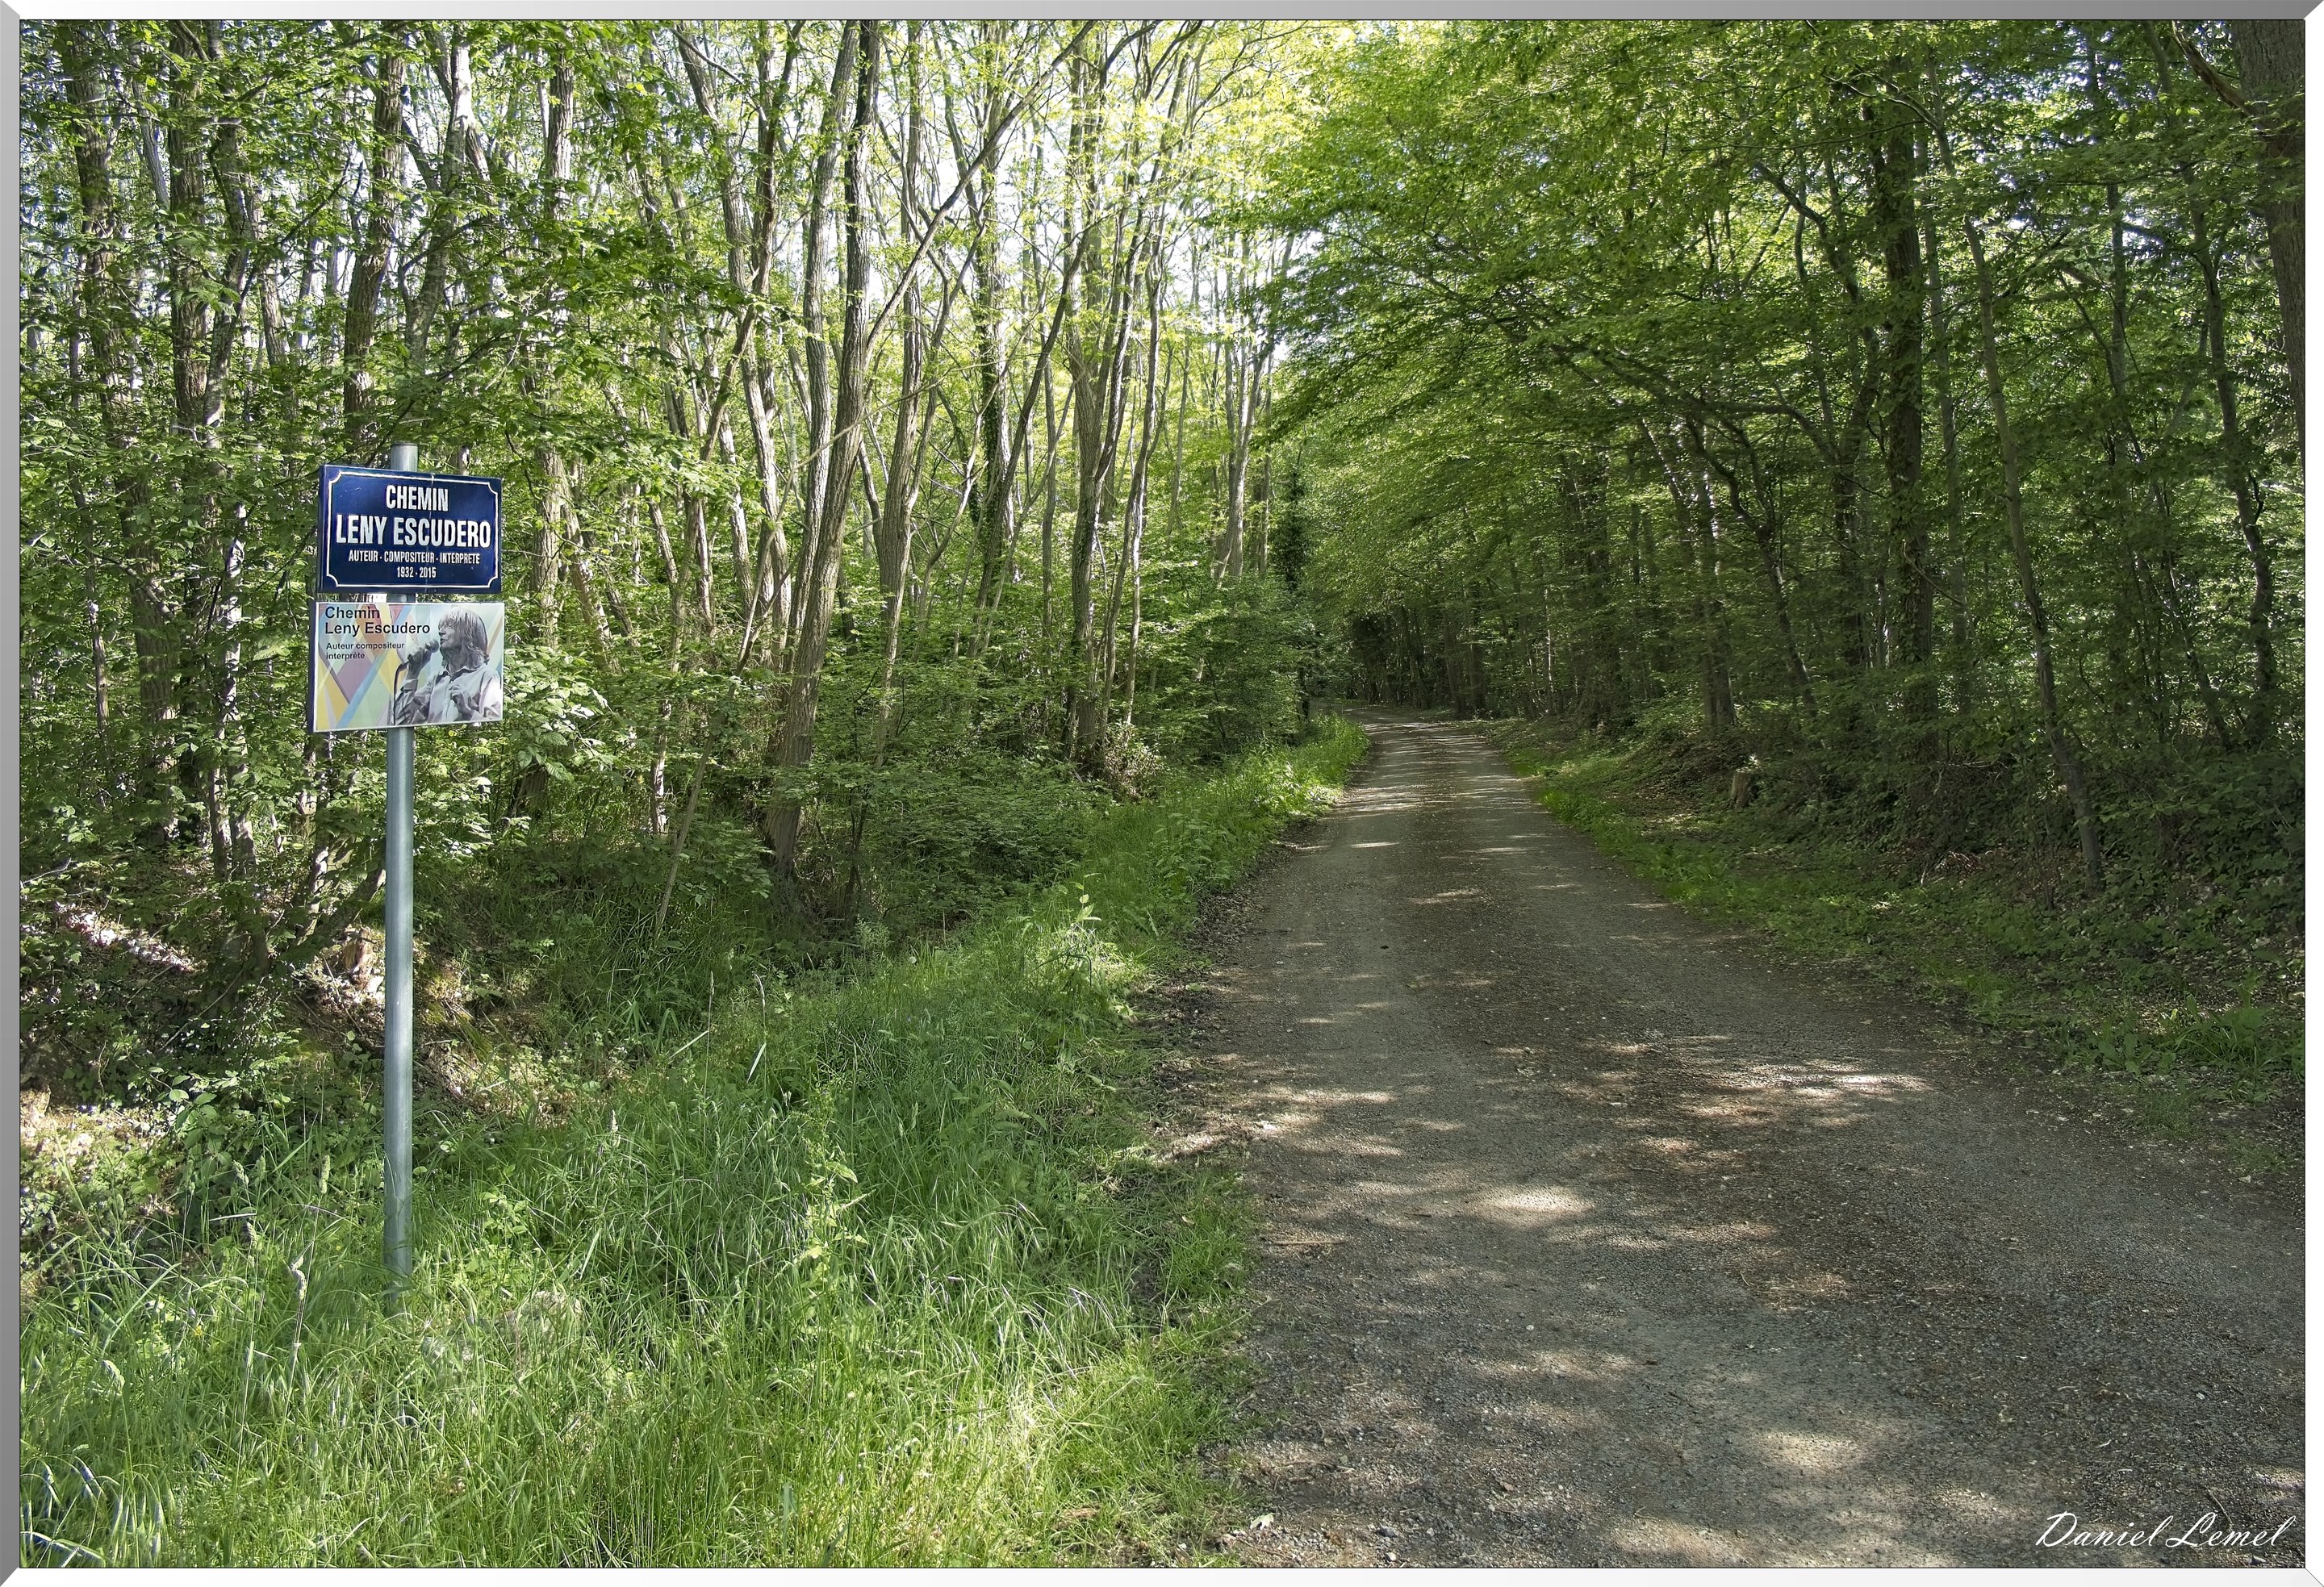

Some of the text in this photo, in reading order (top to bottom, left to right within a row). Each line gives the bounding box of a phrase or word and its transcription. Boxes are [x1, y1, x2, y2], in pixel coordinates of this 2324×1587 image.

[386, 484, 449, 512] CHEMIN
[336, 513, 491, 549] LENY ESCUDERO
[349, 550, 378, 562] AUTEUR
[384, 551, 435, 564] COMPOSITEUR
[397, 566, 437, 578] 1932 2015
[325, 606, 380, 619] Chemin
[325, 622, 430, 637] Leny Escudero
[326, 641, 405, 652] Auteur compositeur
[326, 652, 366, 661] interprète
